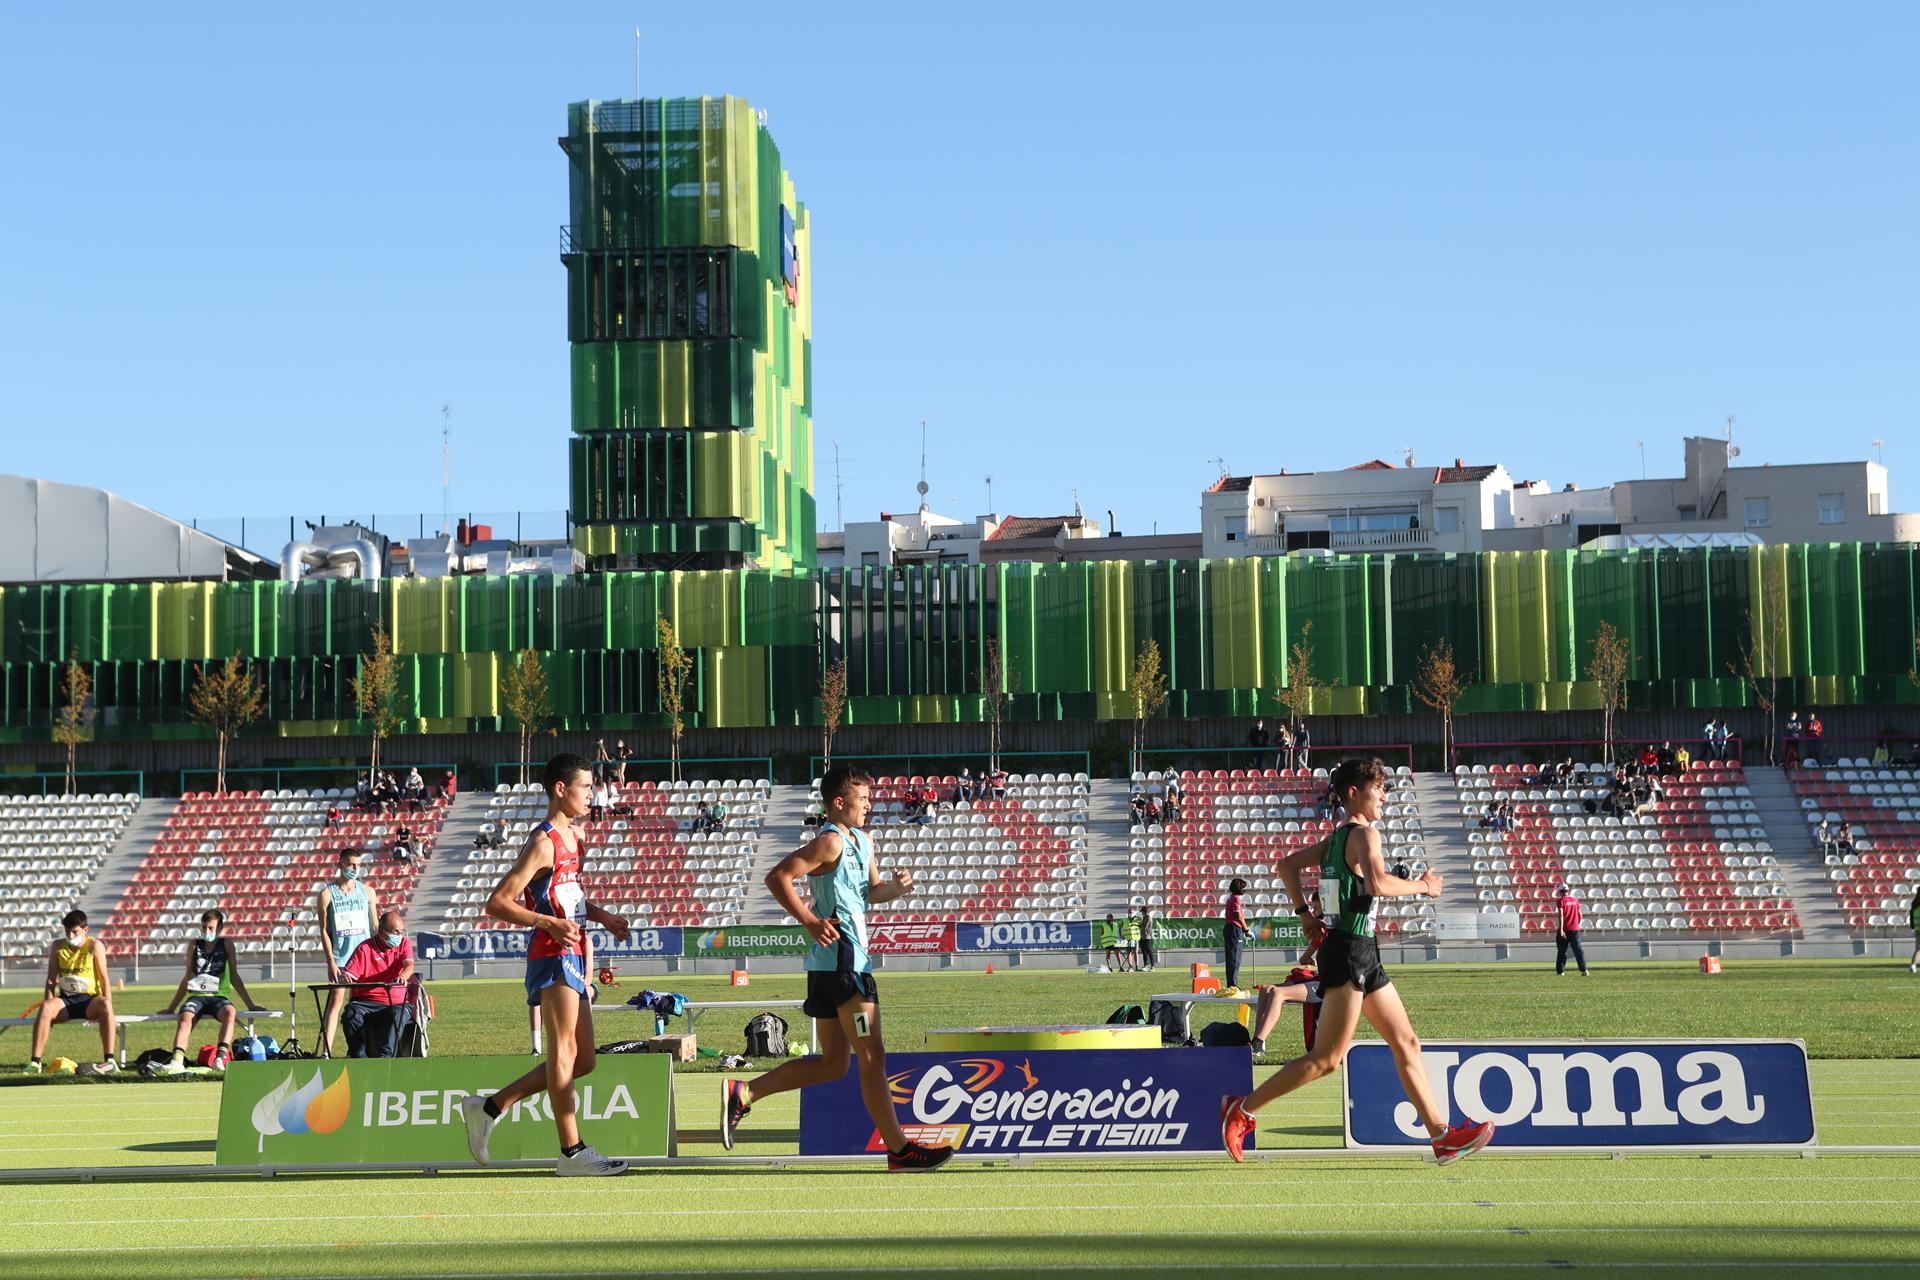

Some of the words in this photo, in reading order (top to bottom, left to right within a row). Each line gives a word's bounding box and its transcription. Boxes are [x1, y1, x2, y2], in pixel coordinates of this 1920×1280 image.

[588, 930, 664, 952] oma
[727, 935, 806, 947] IBERDROLA
[976, 922, 1072, 949] Joma
[1151, 927, 1217, 940] ERDROLA
[1274, 926, 1304, 939] IBER
[868, 941, 941, 950] ATLETISMO
[855, 1015, 867, 1034] 1
[912, 1064, 1180, 1125] Generación
[1393, 1051, 1765, 1139] Joma
[966, 1122, 1189, 1147] ATLETISMO
